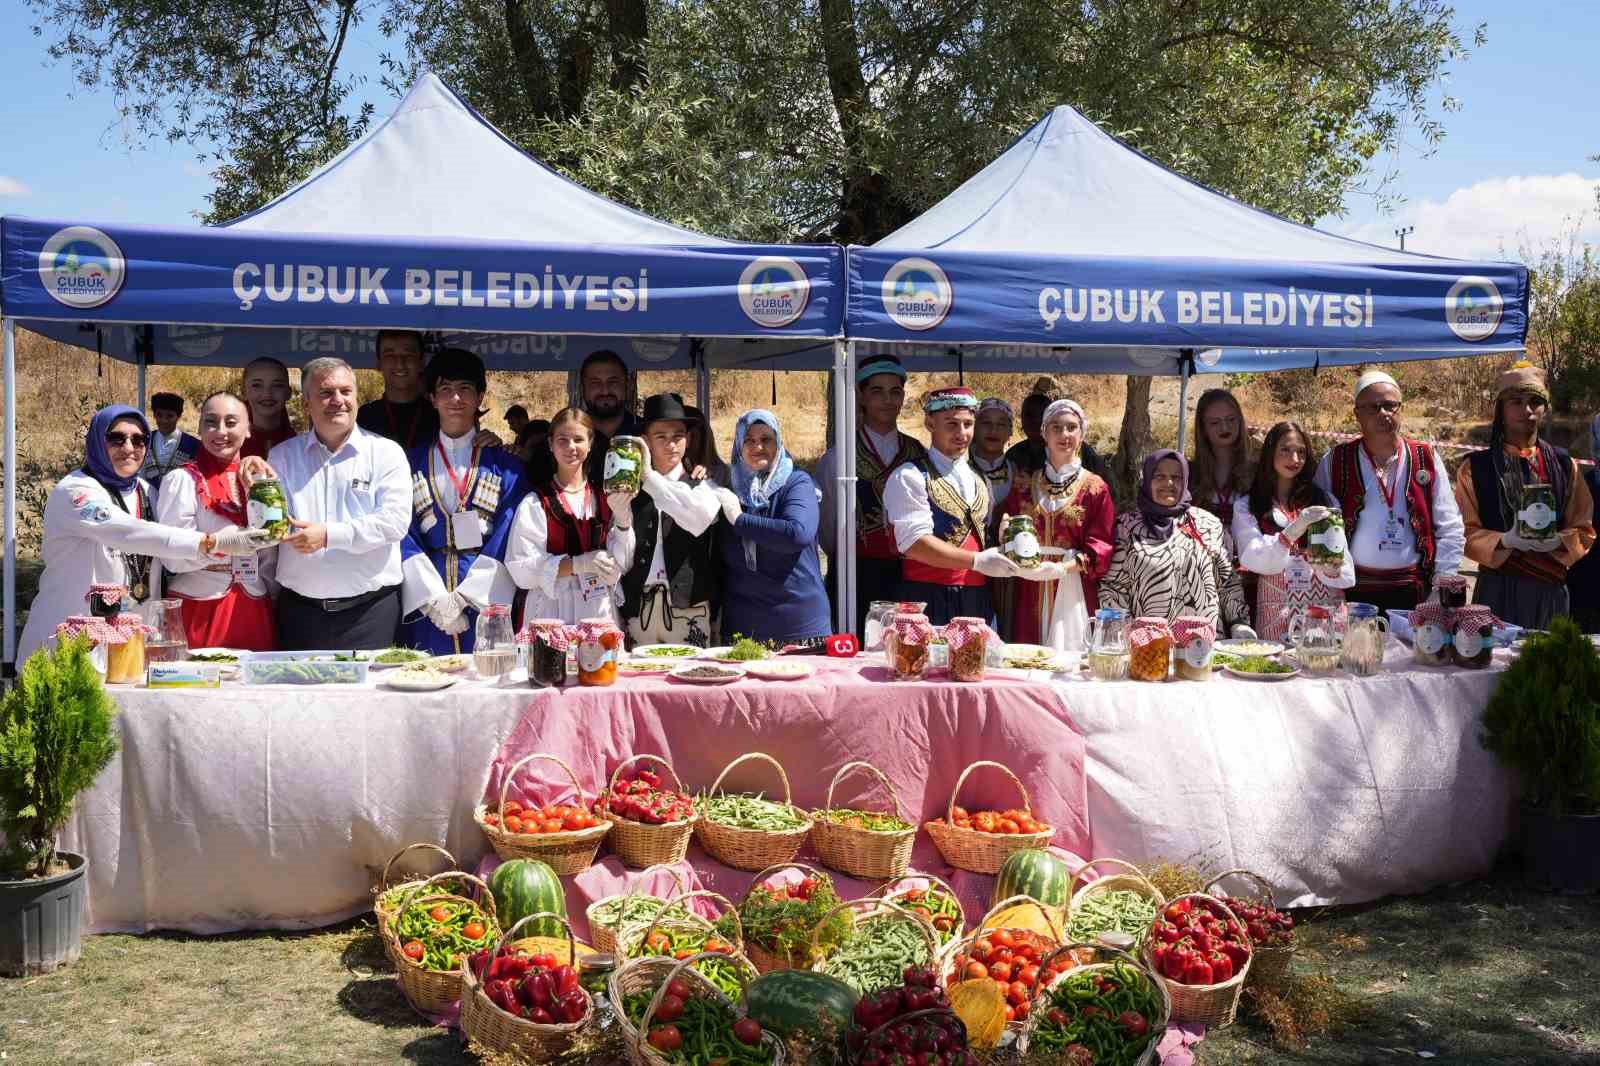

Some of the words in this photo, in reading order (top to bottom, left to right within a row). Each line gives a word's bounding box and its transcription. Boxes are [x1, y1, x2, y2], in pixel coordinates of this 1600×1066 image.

[232, 262, 391, 311] ÇUBUK
[404, 264, 649, 312] BELEDİYESİ
[1038, 286, 1166, 331] ÇUBUK
[1176, 286, 1375, 328] BELEDİYESİ
